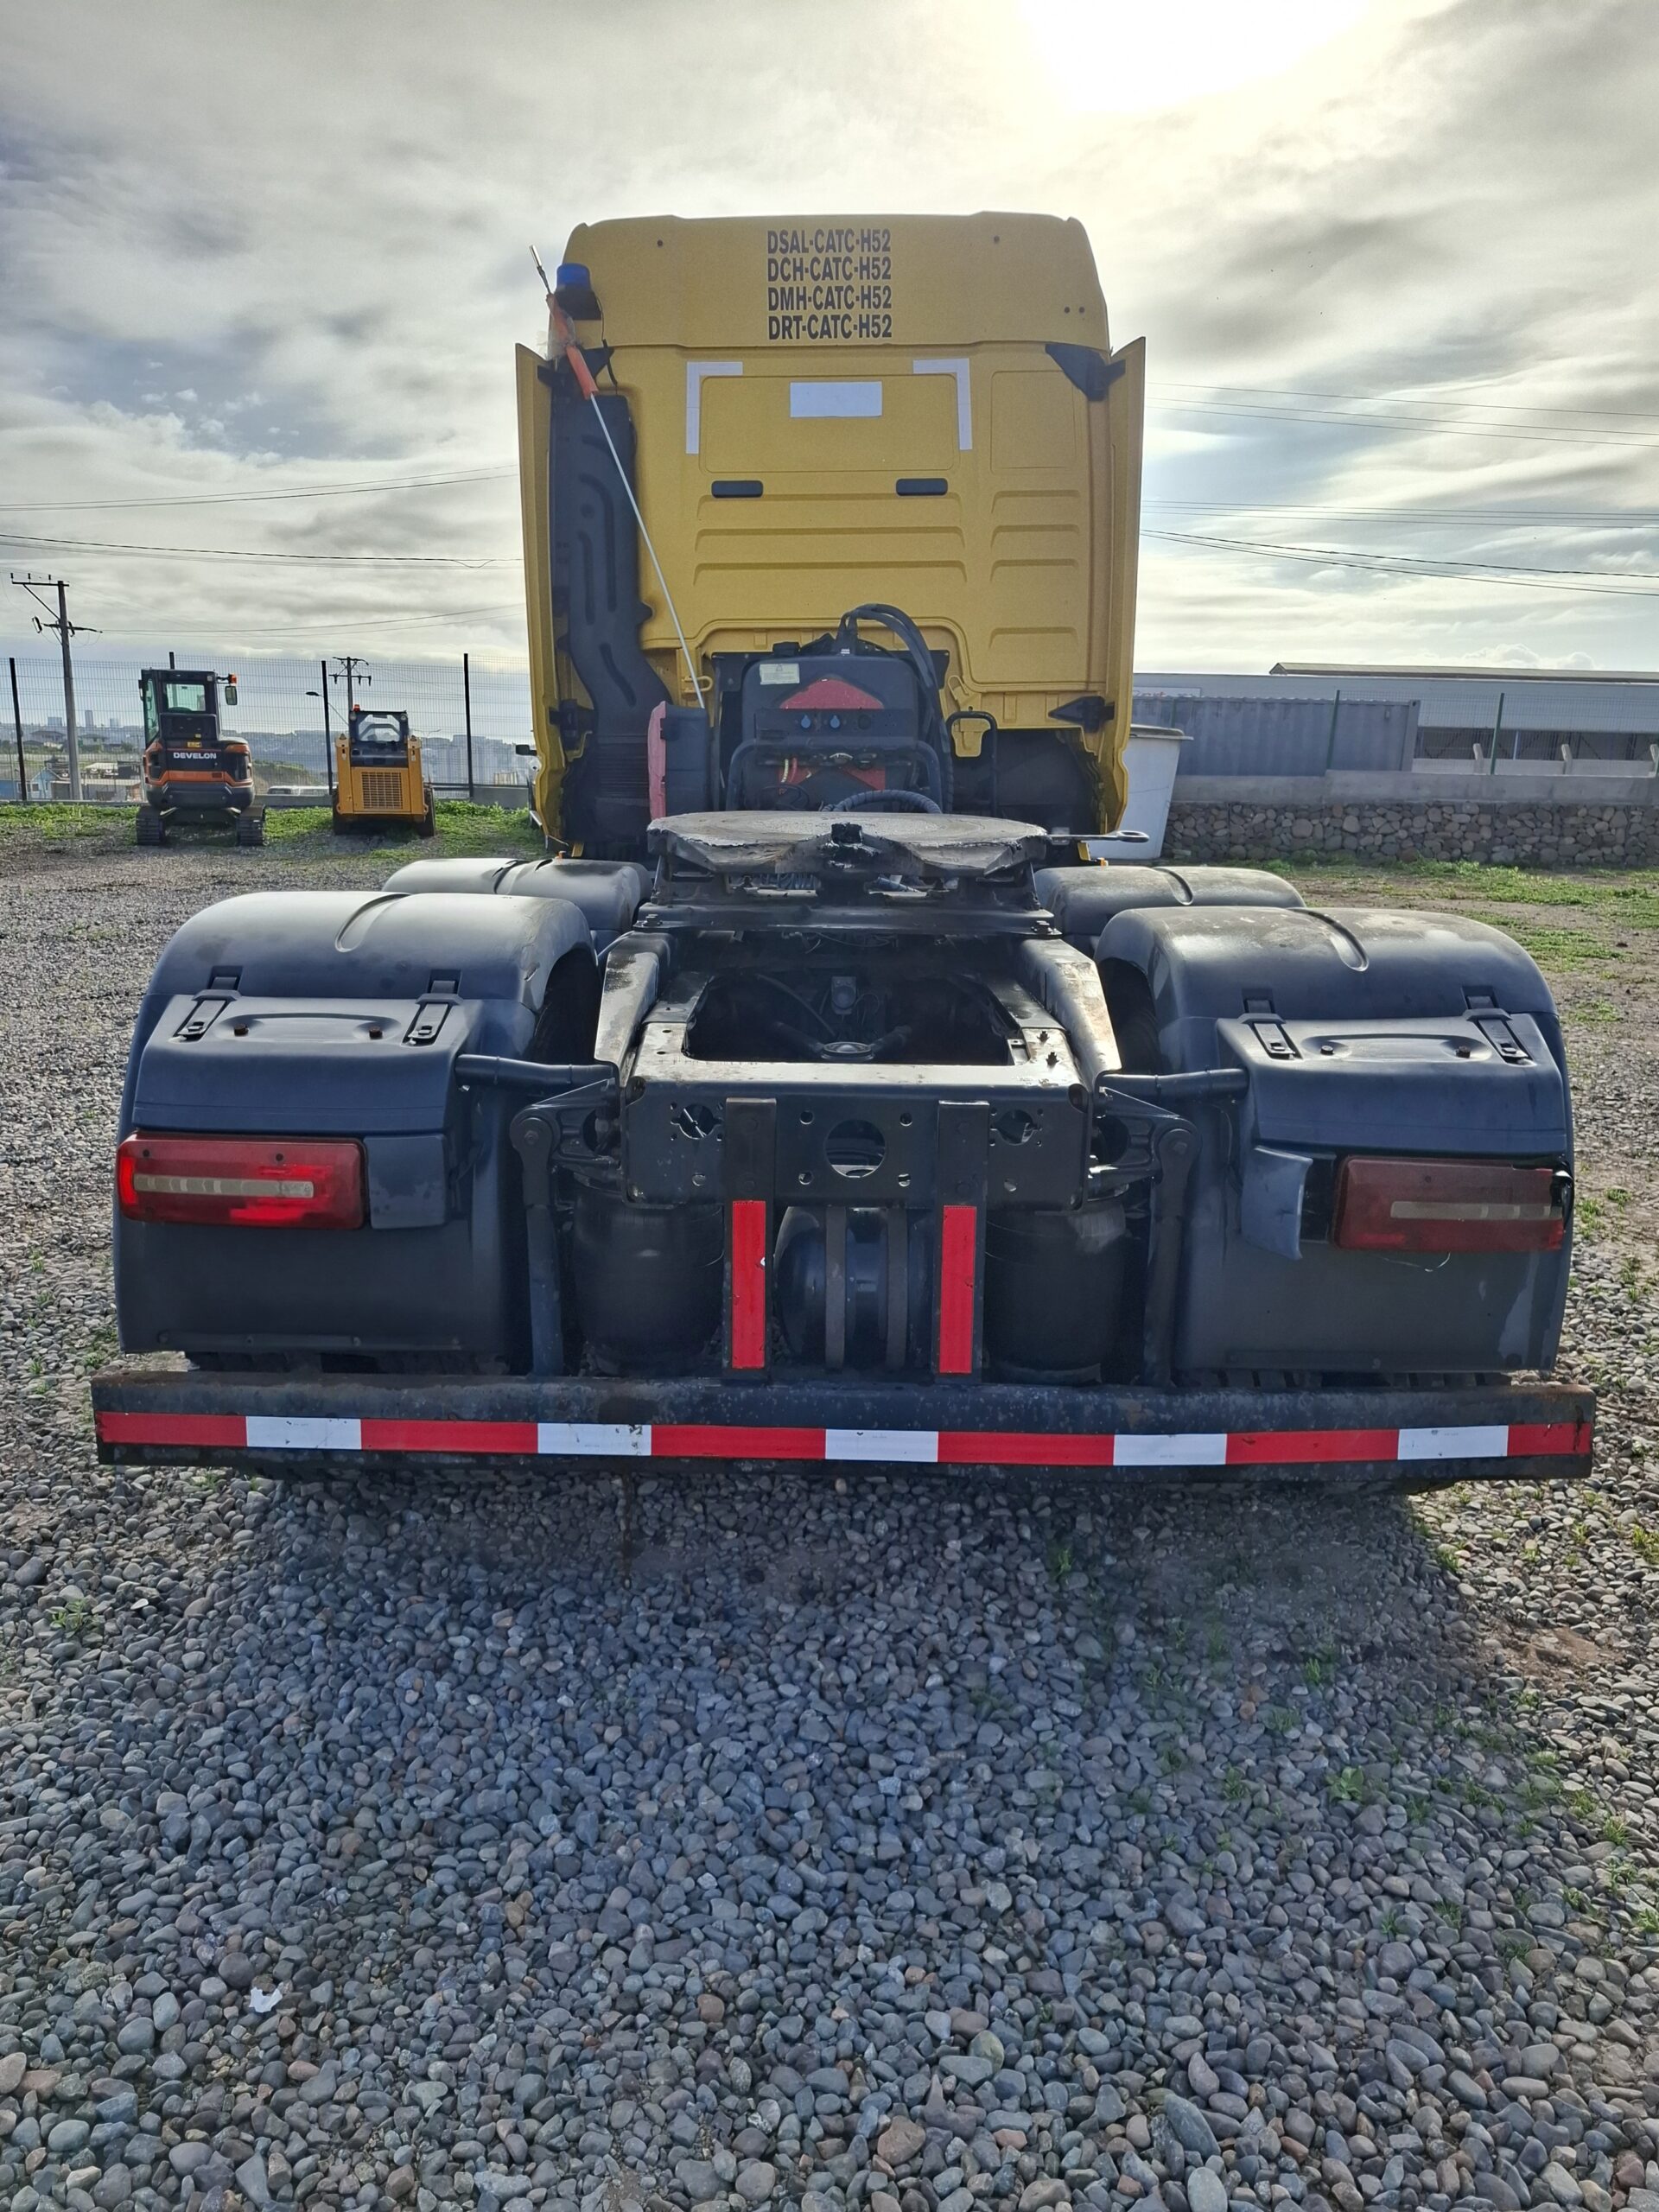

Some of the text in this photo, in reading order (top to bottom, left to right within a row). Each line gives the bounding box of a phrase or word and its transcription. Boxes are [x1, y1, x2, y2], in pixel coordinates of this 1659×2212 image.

[767, 228, 891, 254] DSAL-CATC-H52
[767, 256, 892, 282] DCH-CATC-H52
[767, 285, 892, 311] DMH-CATC-H52
[768, 314, 893, 340] DRT-CATC-H52
